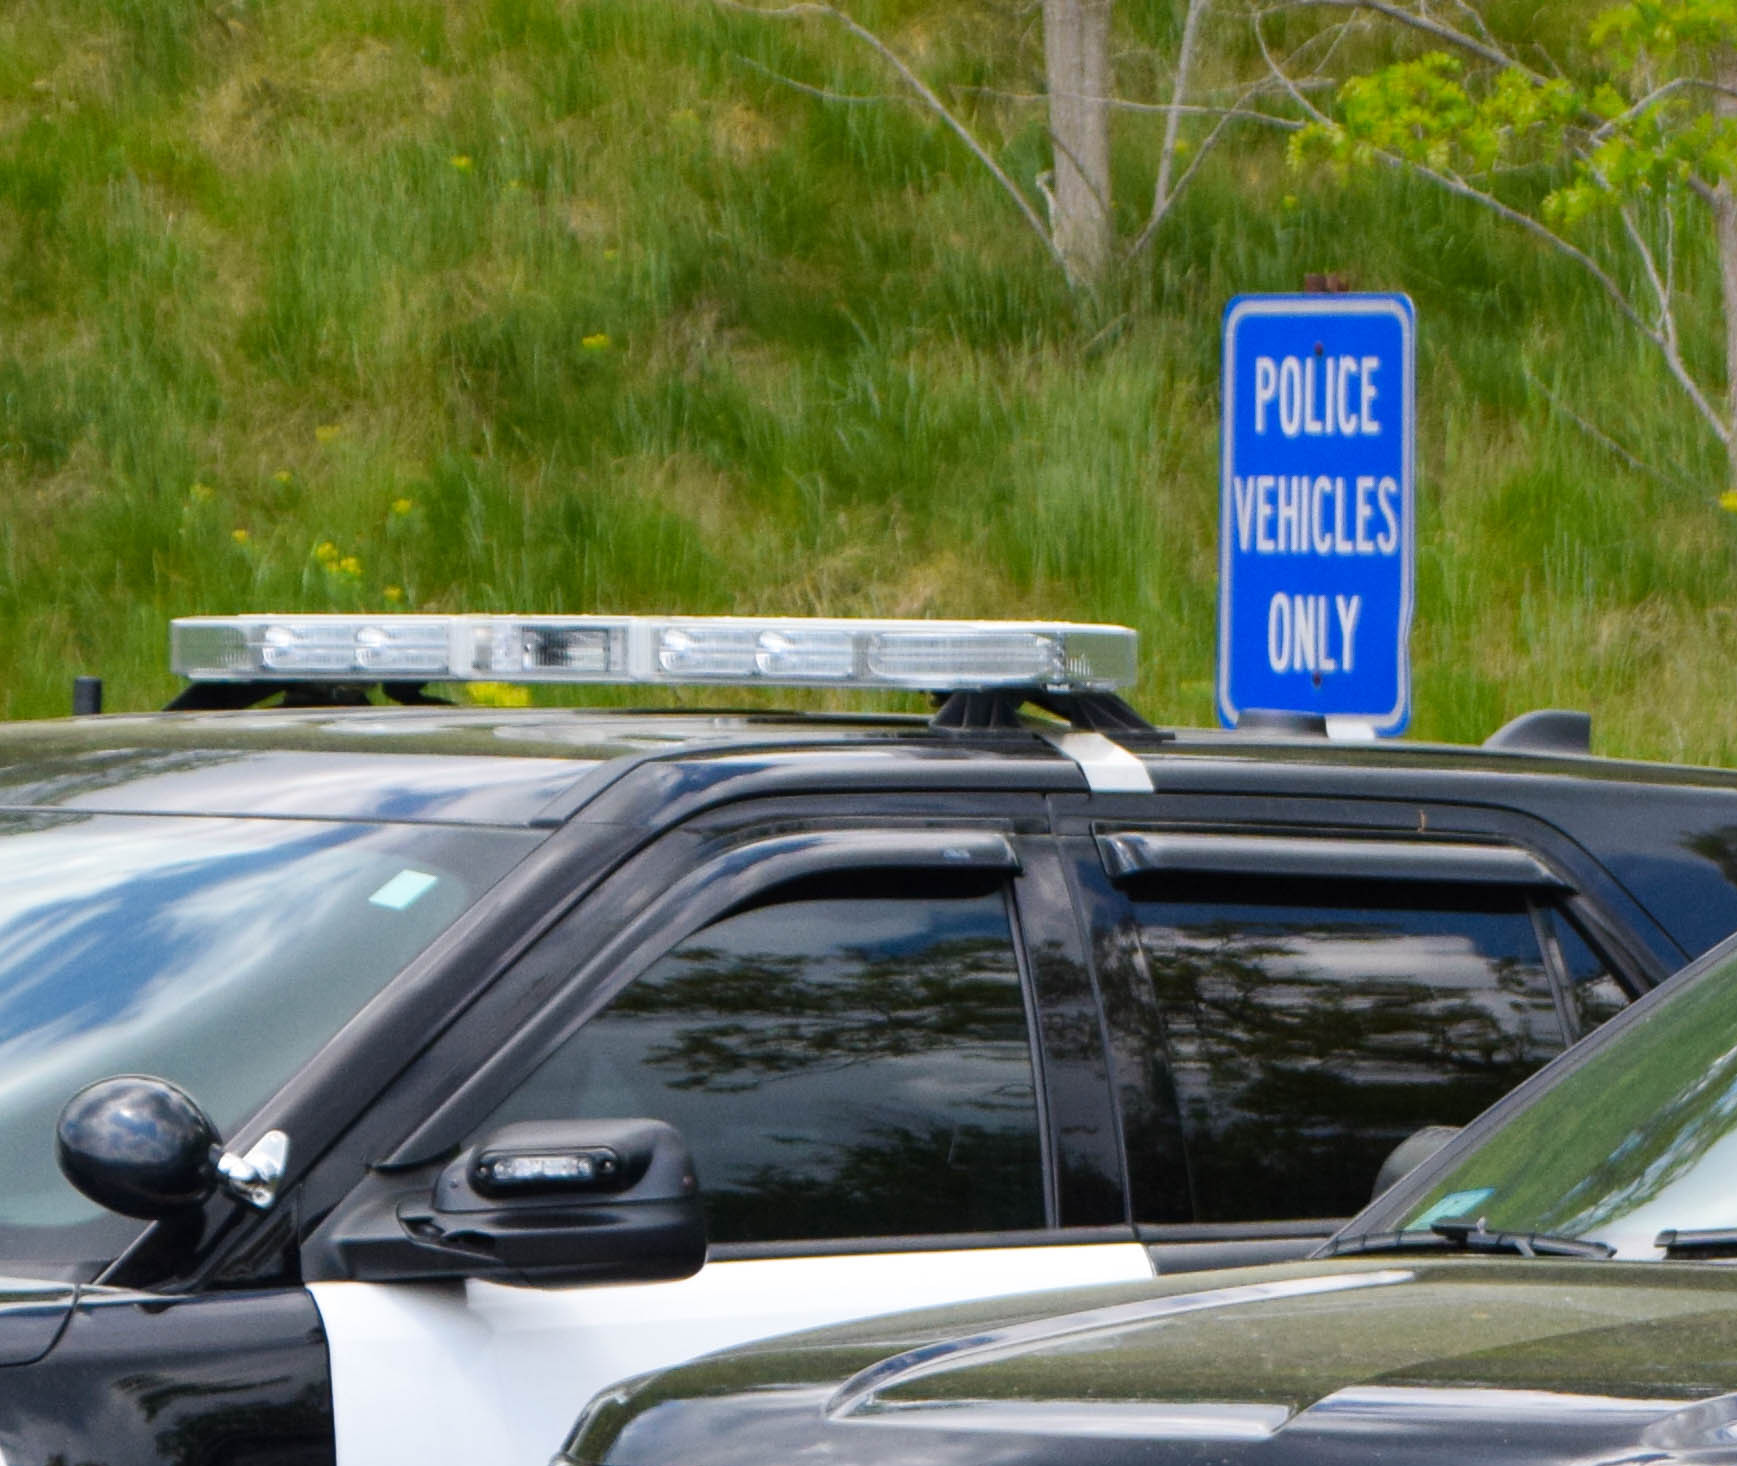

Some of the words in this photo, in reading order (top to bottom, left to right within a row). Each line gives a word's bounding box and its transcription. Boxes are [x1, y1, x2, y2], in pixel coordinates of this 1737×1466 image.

[1255, 355, 1380, 437] POLICE
[1234, 475, 1399, 556] VEHICLES
[1267, 591, 1361, 674] ONLY
